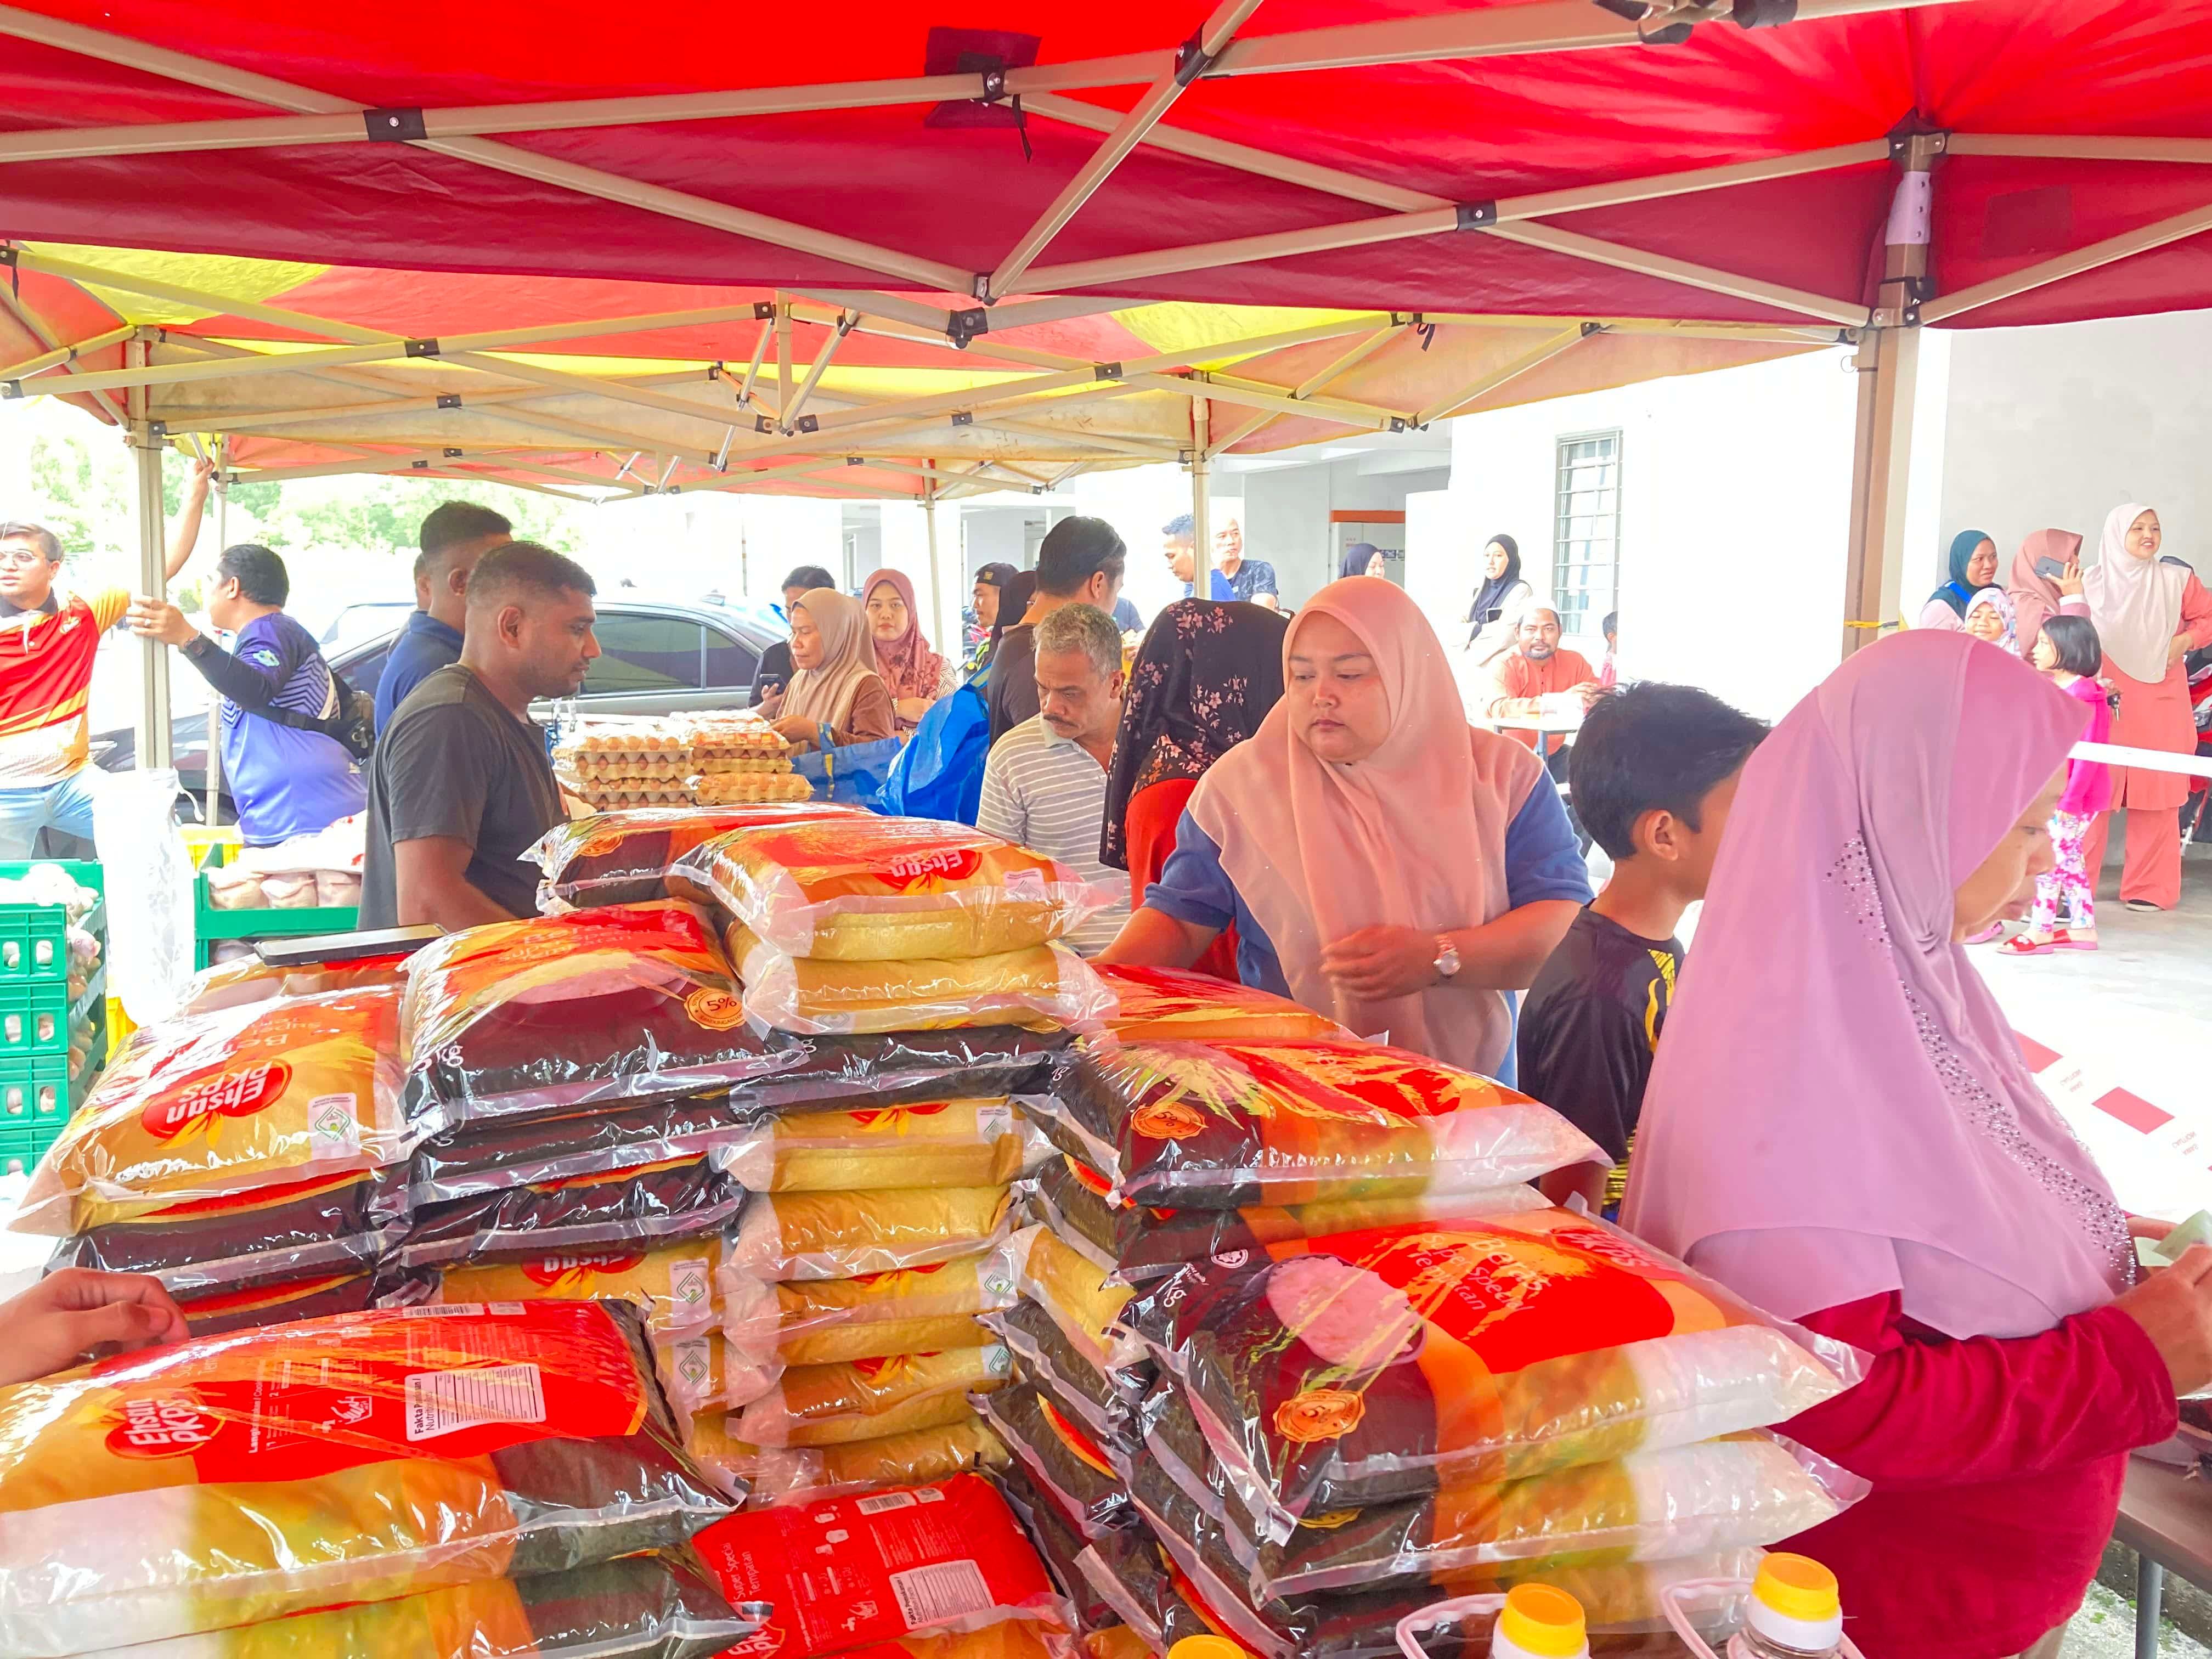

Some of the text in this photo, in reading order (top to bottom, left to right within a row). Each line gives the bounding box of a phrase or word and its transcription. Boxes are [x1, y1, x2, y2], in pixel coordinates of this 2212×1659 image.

[890, 850, 963, 877] Ehsan
[707, 997, 737, 1012] 5%
[166, 1075, 267, 1124] Ehsan
[1468, 1238, 1552, 1292] Beras
[123, 1397, 172, 1445] Ehsan
[414, 1408, 424, 1435] Fakta
[719, 1542, 746, 1600] Super Special
[741, 1551, 761, 1596] Tempatan
